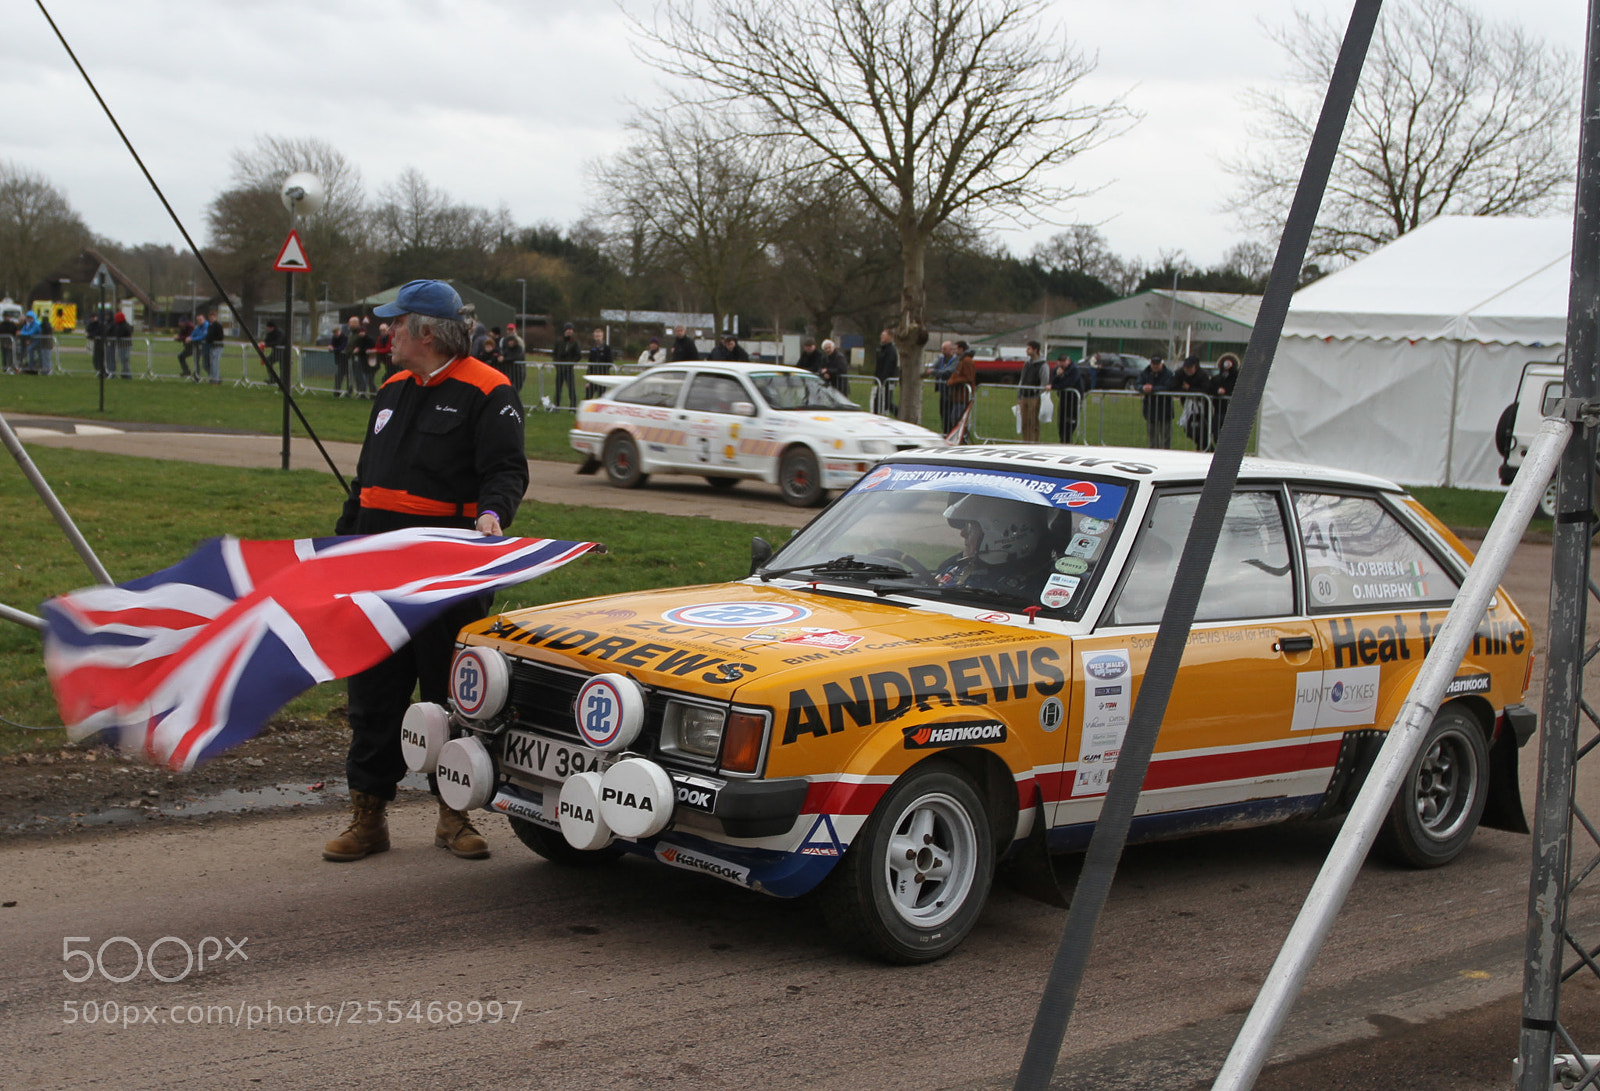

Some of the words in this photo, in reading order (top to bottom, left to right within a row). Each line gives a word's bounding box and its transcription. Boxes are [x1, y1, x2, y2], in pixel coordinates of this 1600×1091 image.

[1076, 318, 1095, 328] THE
[1098, 318, 1138, 329] KENNEL
[1141, 320, 1167, 330] CLUB
[1348, 561, 1405, 577] J.O'BRIEN
[1318, 581, 1331, 596] 80
[1352, 582, 1412, 599] O.MURPHY
[626, 620, 780, 655] ZUTEC
[1223, 628, 1242, 642] Heat
[1245, 627, 1256, 639] for
[1328, 614, 1411, 668] Heat
[479, 620, 757, 684] ANDREWS
[674, 638, 749, 660] Management
[782, 652, 829, 665] BIM
[829, 647, 862, 656] for
[865, 629, 994, 650] Construction
[781, 646, 1065, 745] ANDREWS
[1296, 687, 1331, 704] HUNT
[1343, 683, 1376, 700] SYKES
[402, 728, 427, 749] PIAA
[505, 733, 550, 772] KKV
[438, 765, 471, 788] PIAA
[602, 787, 653, 812] PIAA
[560, 801, 595, 824] PIAA
[801, 847, 839, 856] PACE
